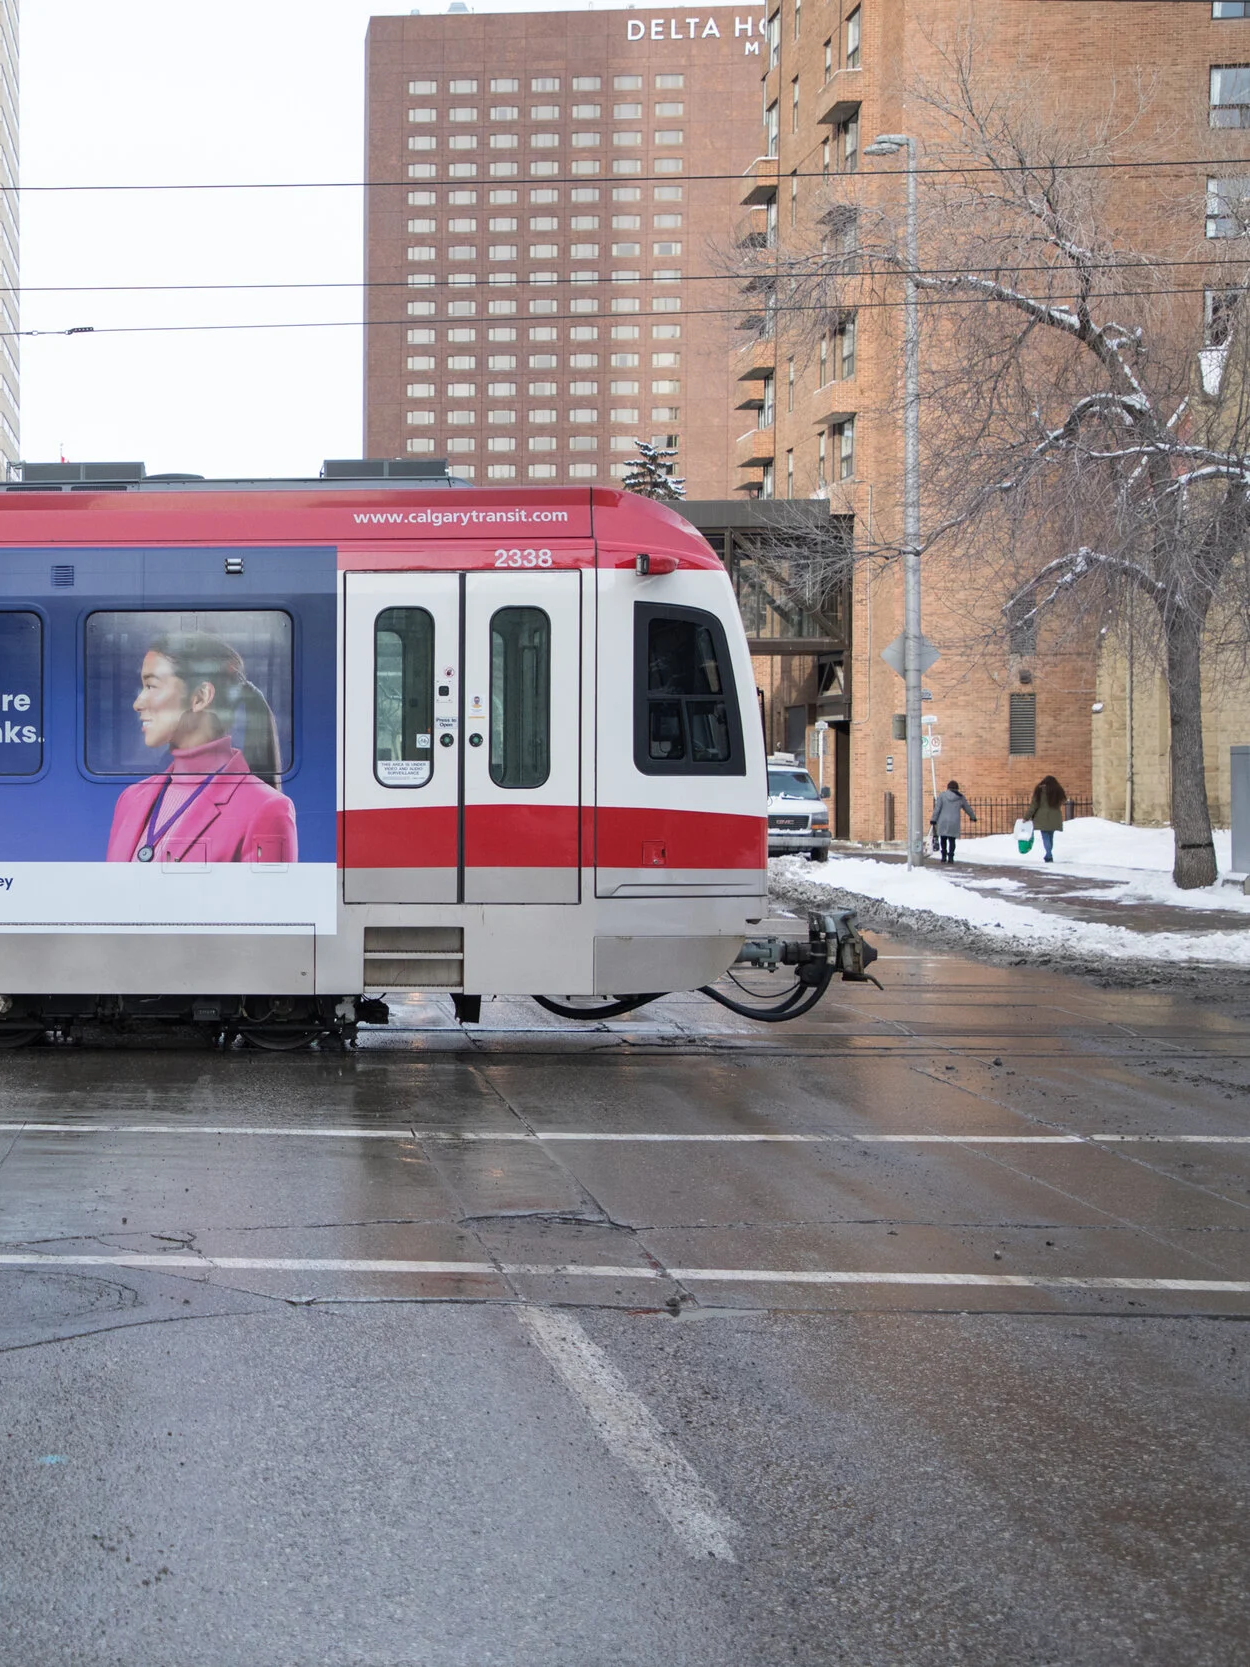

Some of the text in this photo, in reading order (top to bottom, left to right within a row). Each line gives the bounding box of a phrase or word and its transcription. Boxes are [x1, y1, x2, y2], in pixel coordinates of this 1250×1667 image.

[627, 17, 720, 41] DELTA
[353, 508, 568, 526] www.calgarytransit.com
[494, 548, 552, 567] 2338
